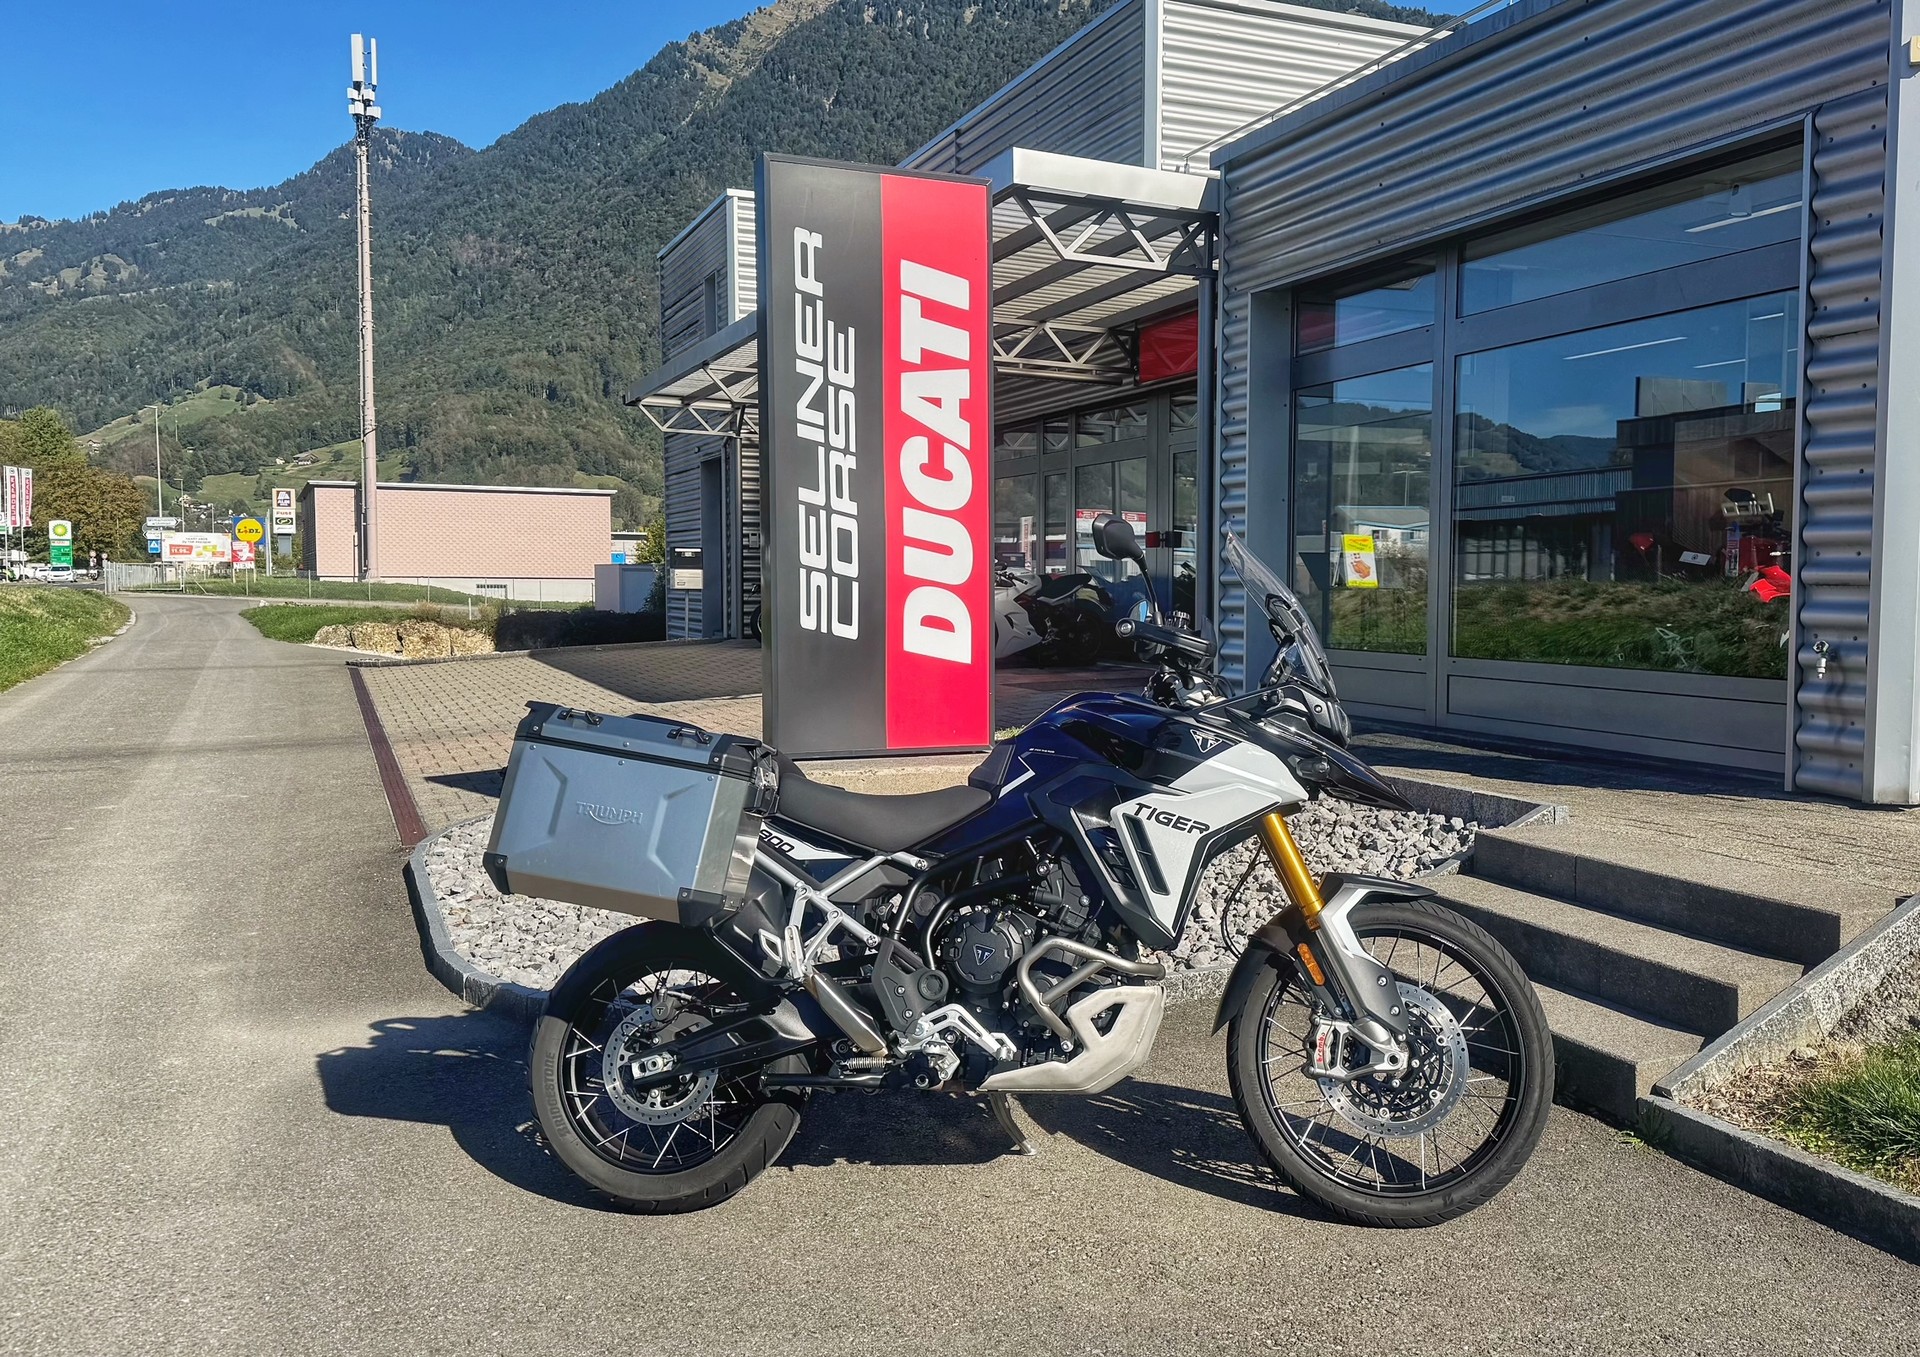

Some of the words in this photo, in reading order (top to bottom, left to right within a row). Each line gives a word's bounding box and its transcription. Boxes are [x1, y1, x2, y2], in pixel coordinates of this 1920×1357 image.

[793, 226, 828, 634] SELINER
[827, 319, 860, 641] CORSE
[899, 258, 974, 664] DUCATI
[576, 800, 643, 825] TRIUMPH
[759, 829, 795, 853] 900
[1134, 802, 1210, 835] TIGER
[1316, 1032, 1326, 1063] brembo
[543, 1051, 571, 1138] BRIDGESTONE
